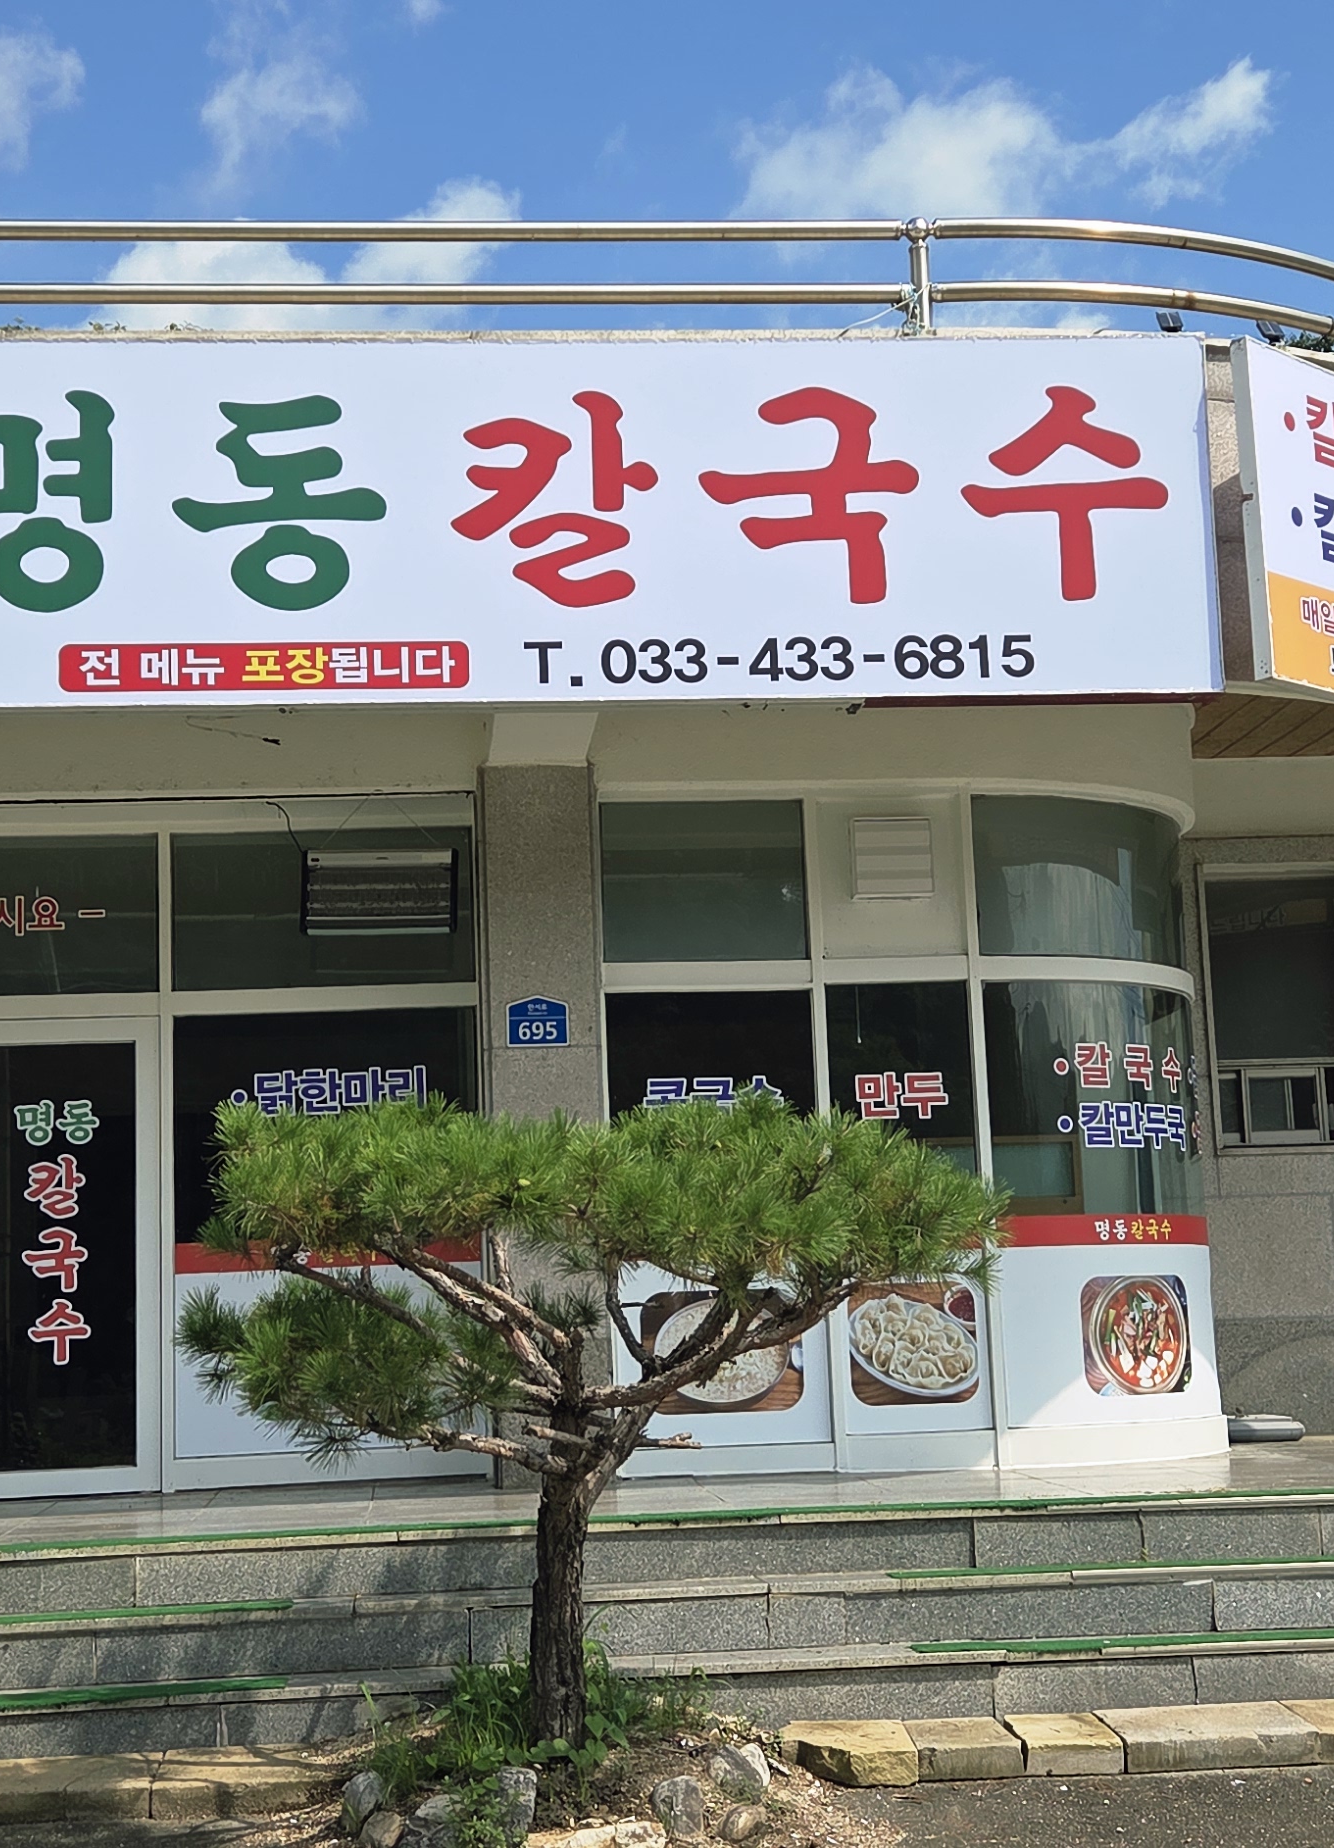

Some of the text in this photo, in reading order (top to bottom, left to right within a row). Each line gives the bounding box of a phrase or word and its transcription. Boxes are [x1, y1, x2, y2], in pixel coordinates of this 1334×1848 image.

[79, 645, 456, 686] 전 메뉴 포장됩니다
[600, 634, 1036, 685] 033-433-6815
[518, 1021, 558, 1041] 695
[855, 1071, 949, 1119] 만두
[14, 1100, 100, 1147] 명동
[1078, 1100, 1187, 1152] 칼만두국
